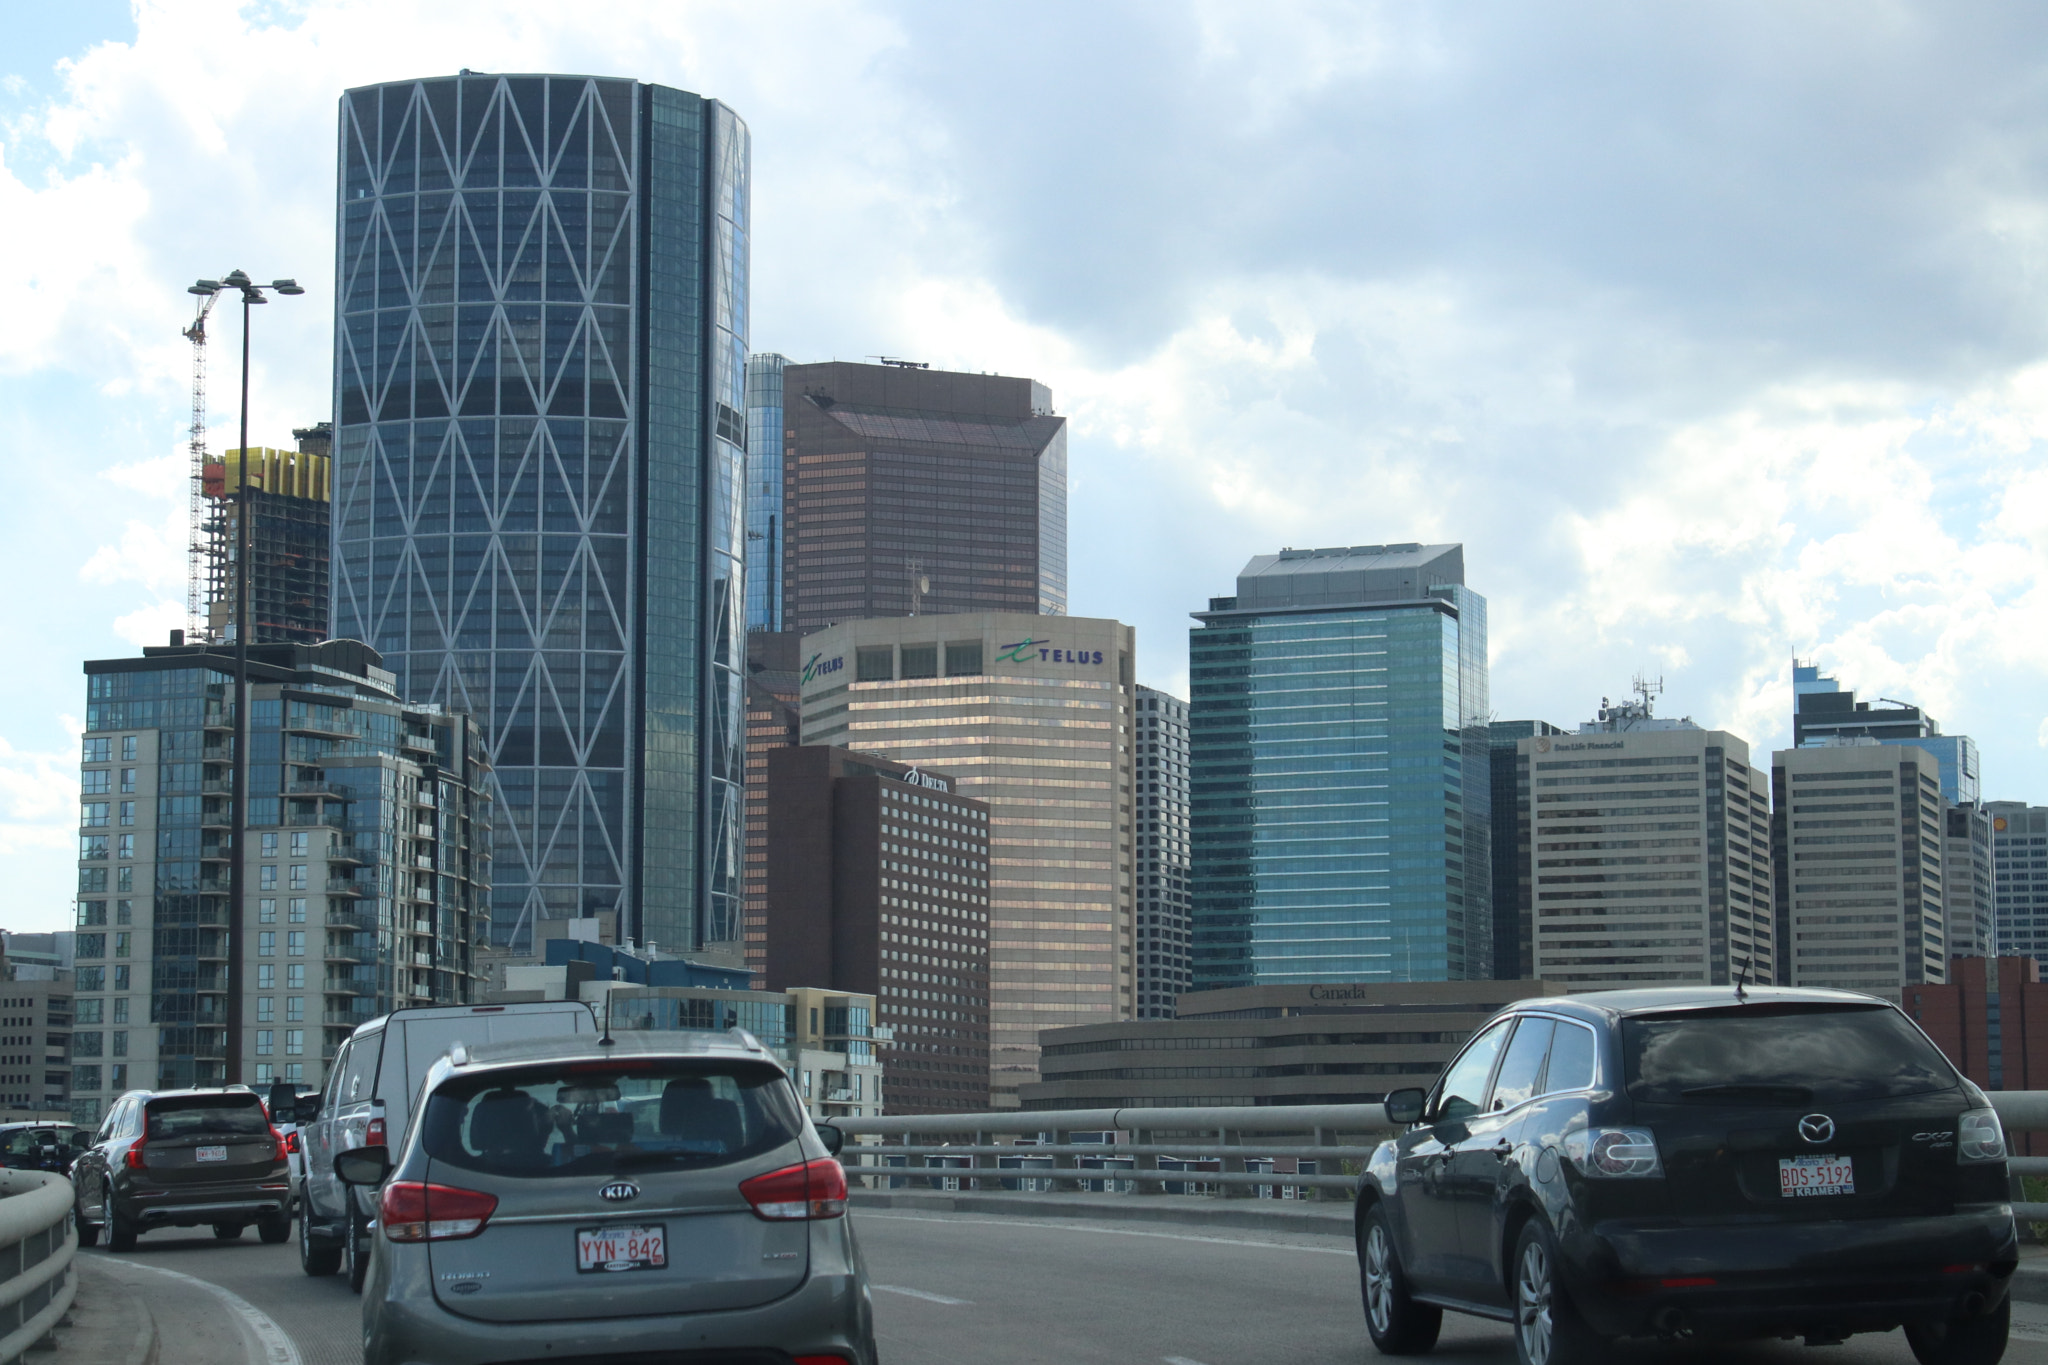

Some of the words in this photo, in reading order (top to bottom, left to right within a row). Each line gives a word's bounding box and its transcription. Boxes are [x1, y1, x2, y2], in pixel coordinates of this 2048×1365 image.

[1039, 649, 1103, 664] TELUS
[817, 656, 844, 676] TELUS
[1587, 741, 1624, 749] Financial
[922, 773, 948, 793] DELTA
[1310, 984, 1366, 1000] Canada
[1911, 1131, 1953, 1141] CX-7
[1781, 1166, 1853, 1187] BDS-5192
[606, 1186, 634, 1198] KIA
[1796, 1186, 1842, 1197] KRAMER
[582, 1237, 662, 1262] YYN-842
